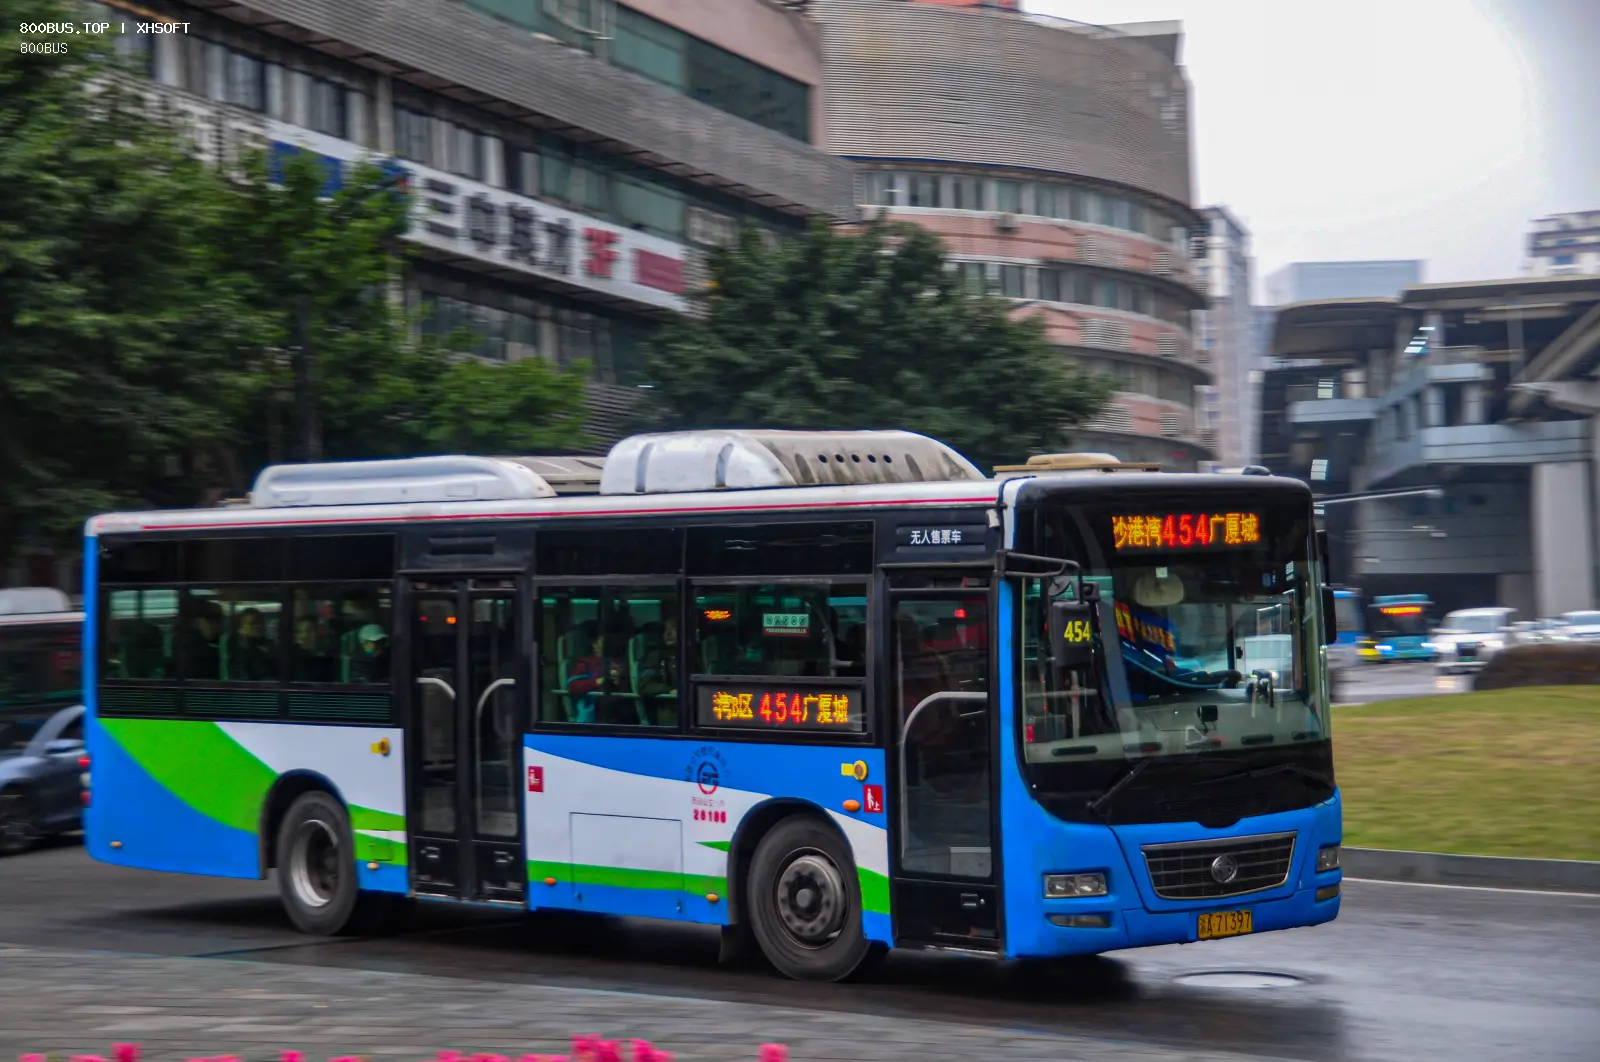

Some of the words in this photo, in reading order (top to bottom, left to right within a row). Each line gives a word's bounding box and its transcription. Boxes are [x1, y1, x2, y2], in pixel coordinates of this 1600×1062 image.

[910, 529, 962, 545] 无人售票车
[1063, 620, 1091, 643] 454
[759, 691, 802, 724] 454
[801, 693, 850, 723] 广厦城
